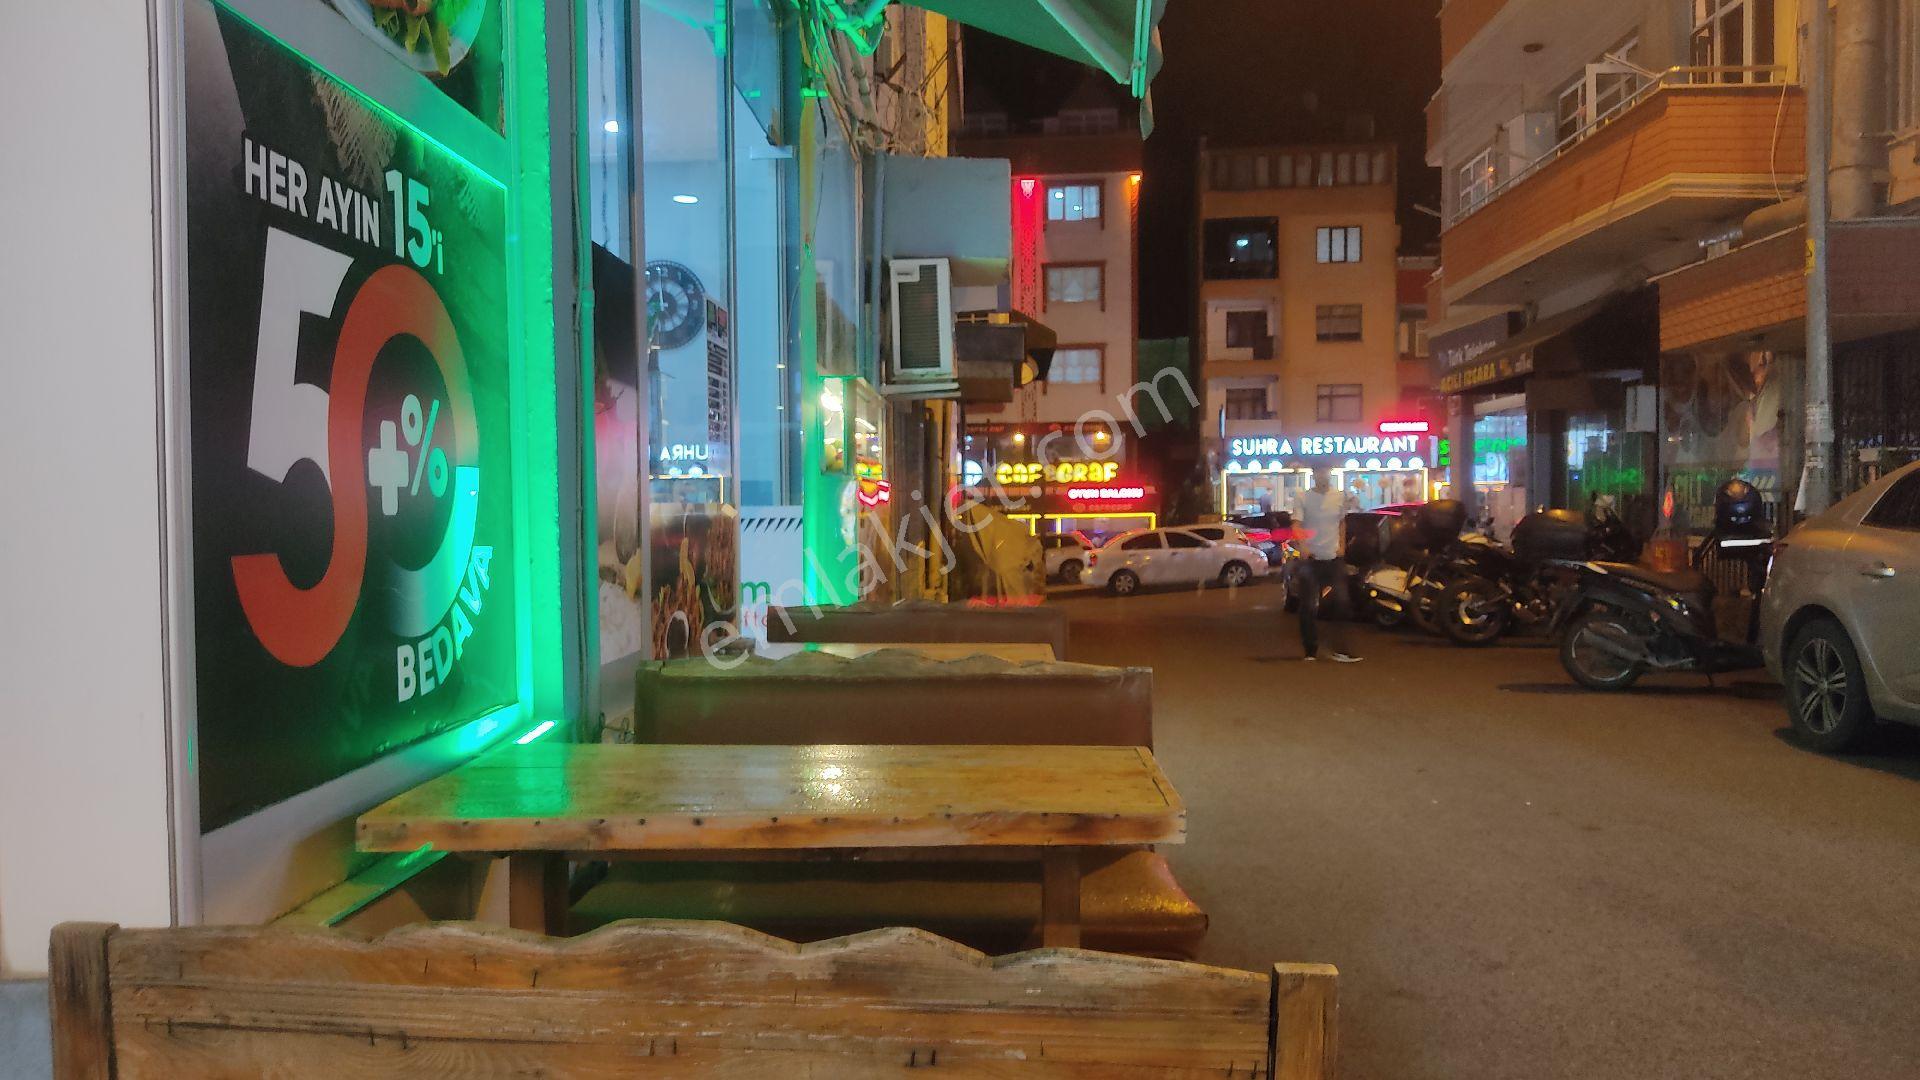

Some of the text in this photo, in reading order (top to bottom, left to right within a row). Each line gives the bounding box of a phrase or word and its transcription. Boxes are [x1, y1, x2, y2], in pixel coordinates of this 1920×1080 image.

[244, 137, 309, 218] HER
[316, 176, 380, 247] AYIN
[231, 225, 480, 668] 50
[1231, 437, 1293, 457] SUHRA
[1300, 435, 1420, 456] RESTAURANT
[397, 545, 494, 704] BEDAVA
